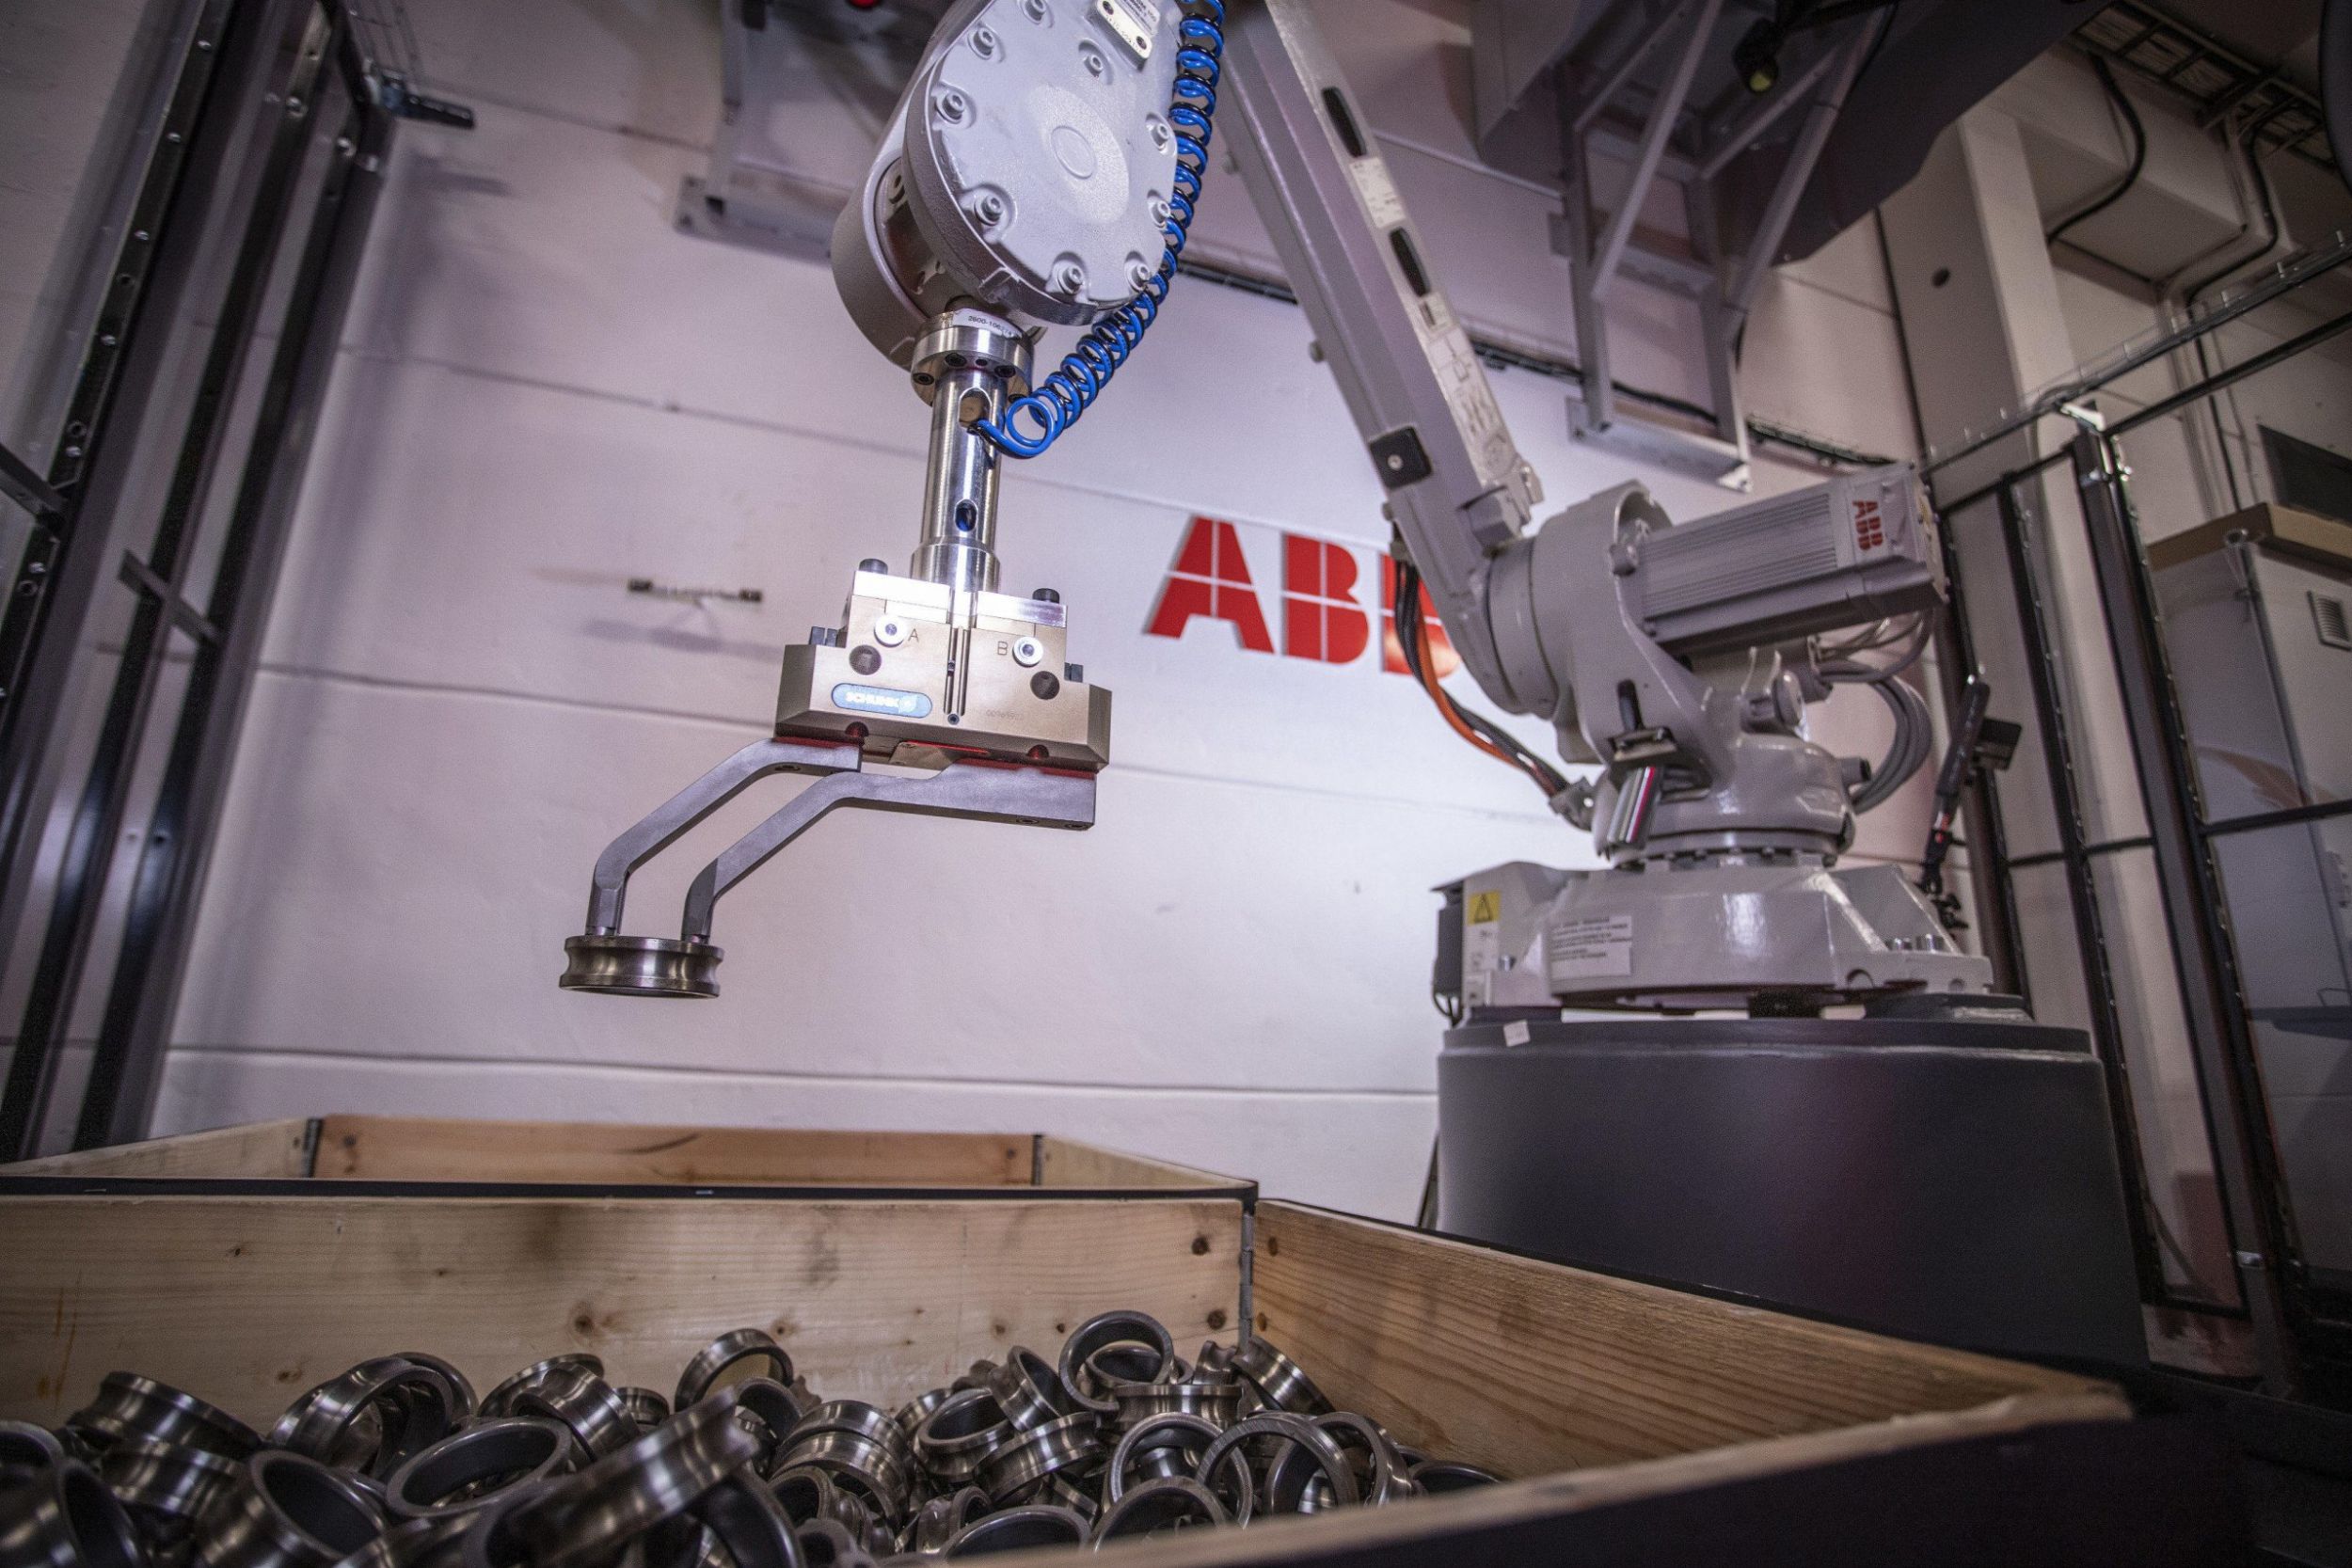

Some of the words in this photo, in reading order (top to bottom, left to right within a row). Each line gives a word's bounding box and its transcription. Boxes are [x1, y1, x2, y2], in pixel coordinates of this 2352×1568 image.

[1852, 500, 1883, 551] ABB
[908, 628, 919, 642] A
[997, 641, 1009, 656] B
